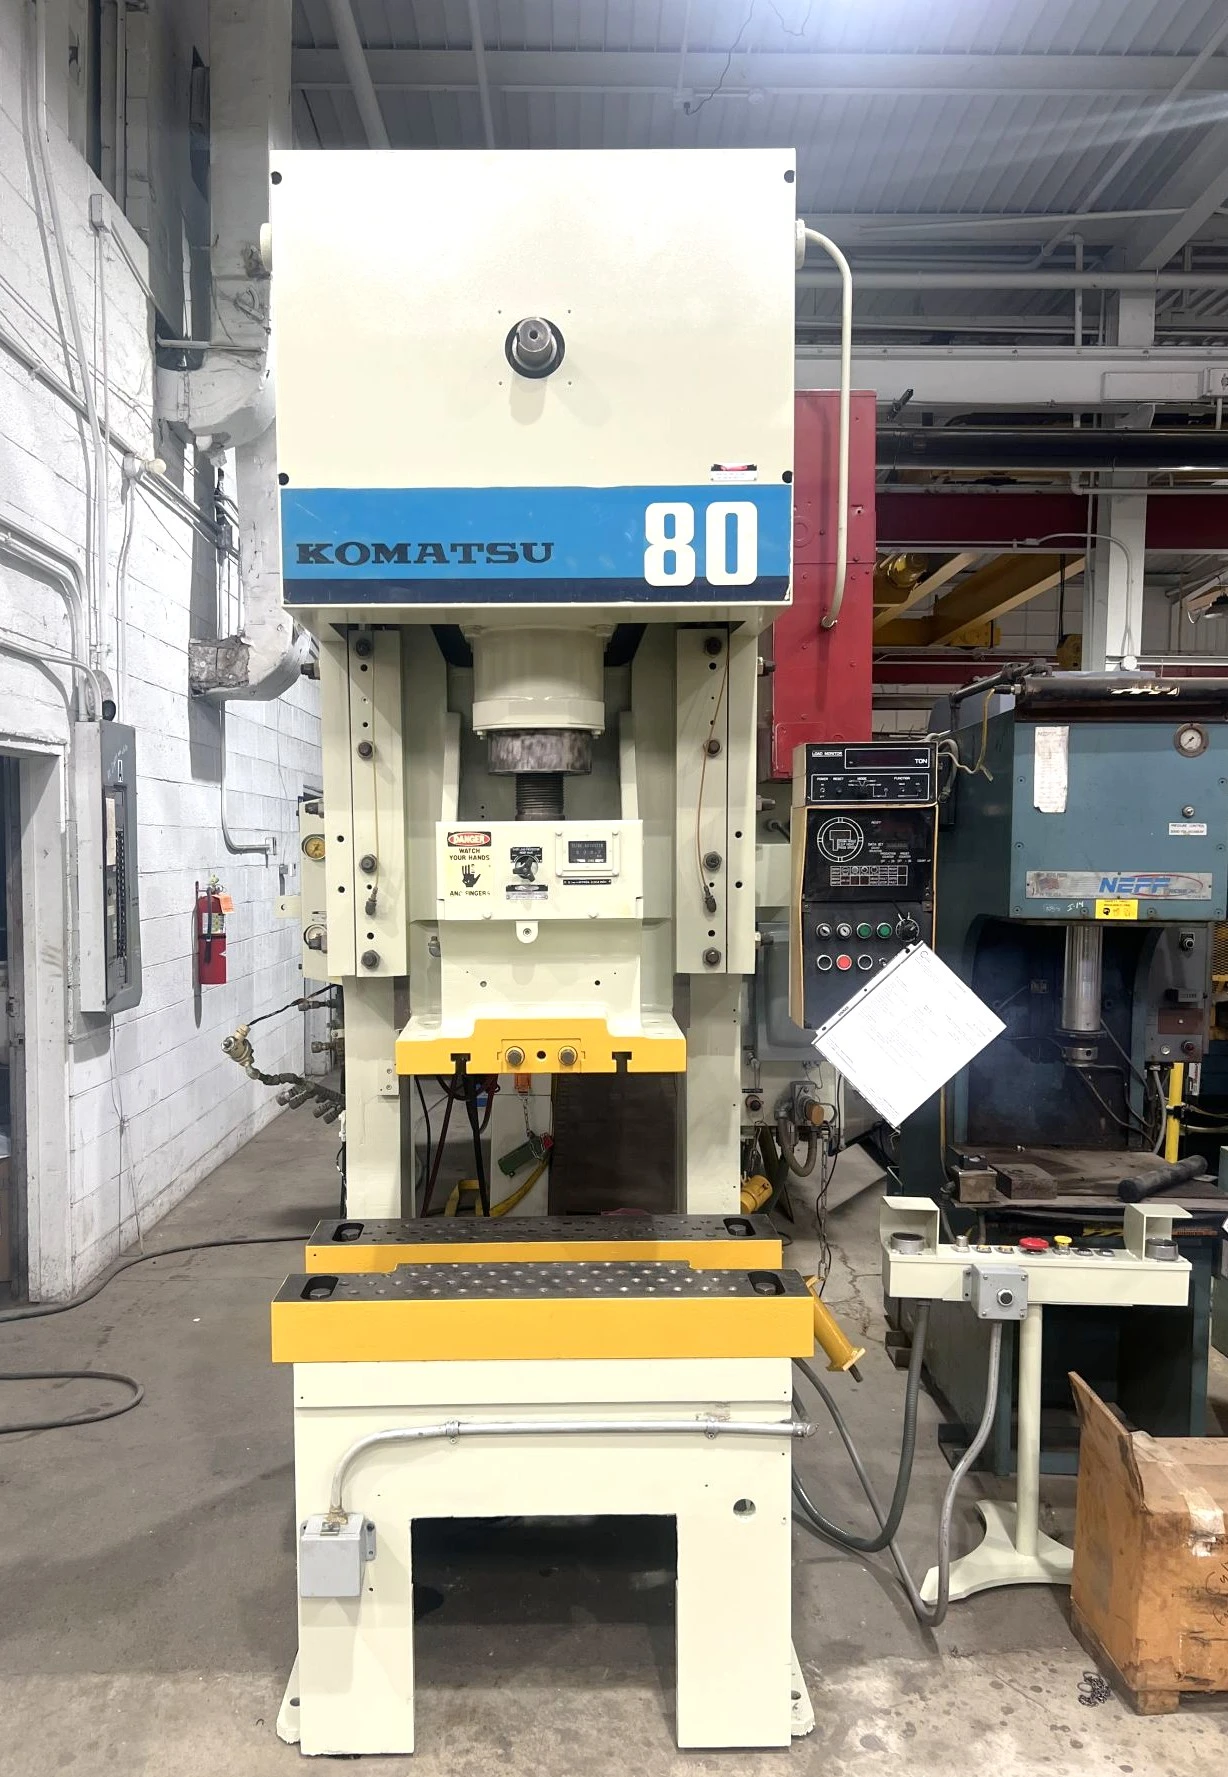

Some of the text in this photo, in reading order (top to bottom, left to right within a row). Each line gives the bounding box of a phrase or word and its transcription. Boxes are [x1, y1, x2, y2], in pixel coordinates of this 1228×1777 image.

[296, 541, 555, 565] KOMATSU
[643, 501, 759, 587] 80
[453, 833, 485, 845] DANGER
[1098, 877, 1171, 893] NEFF
